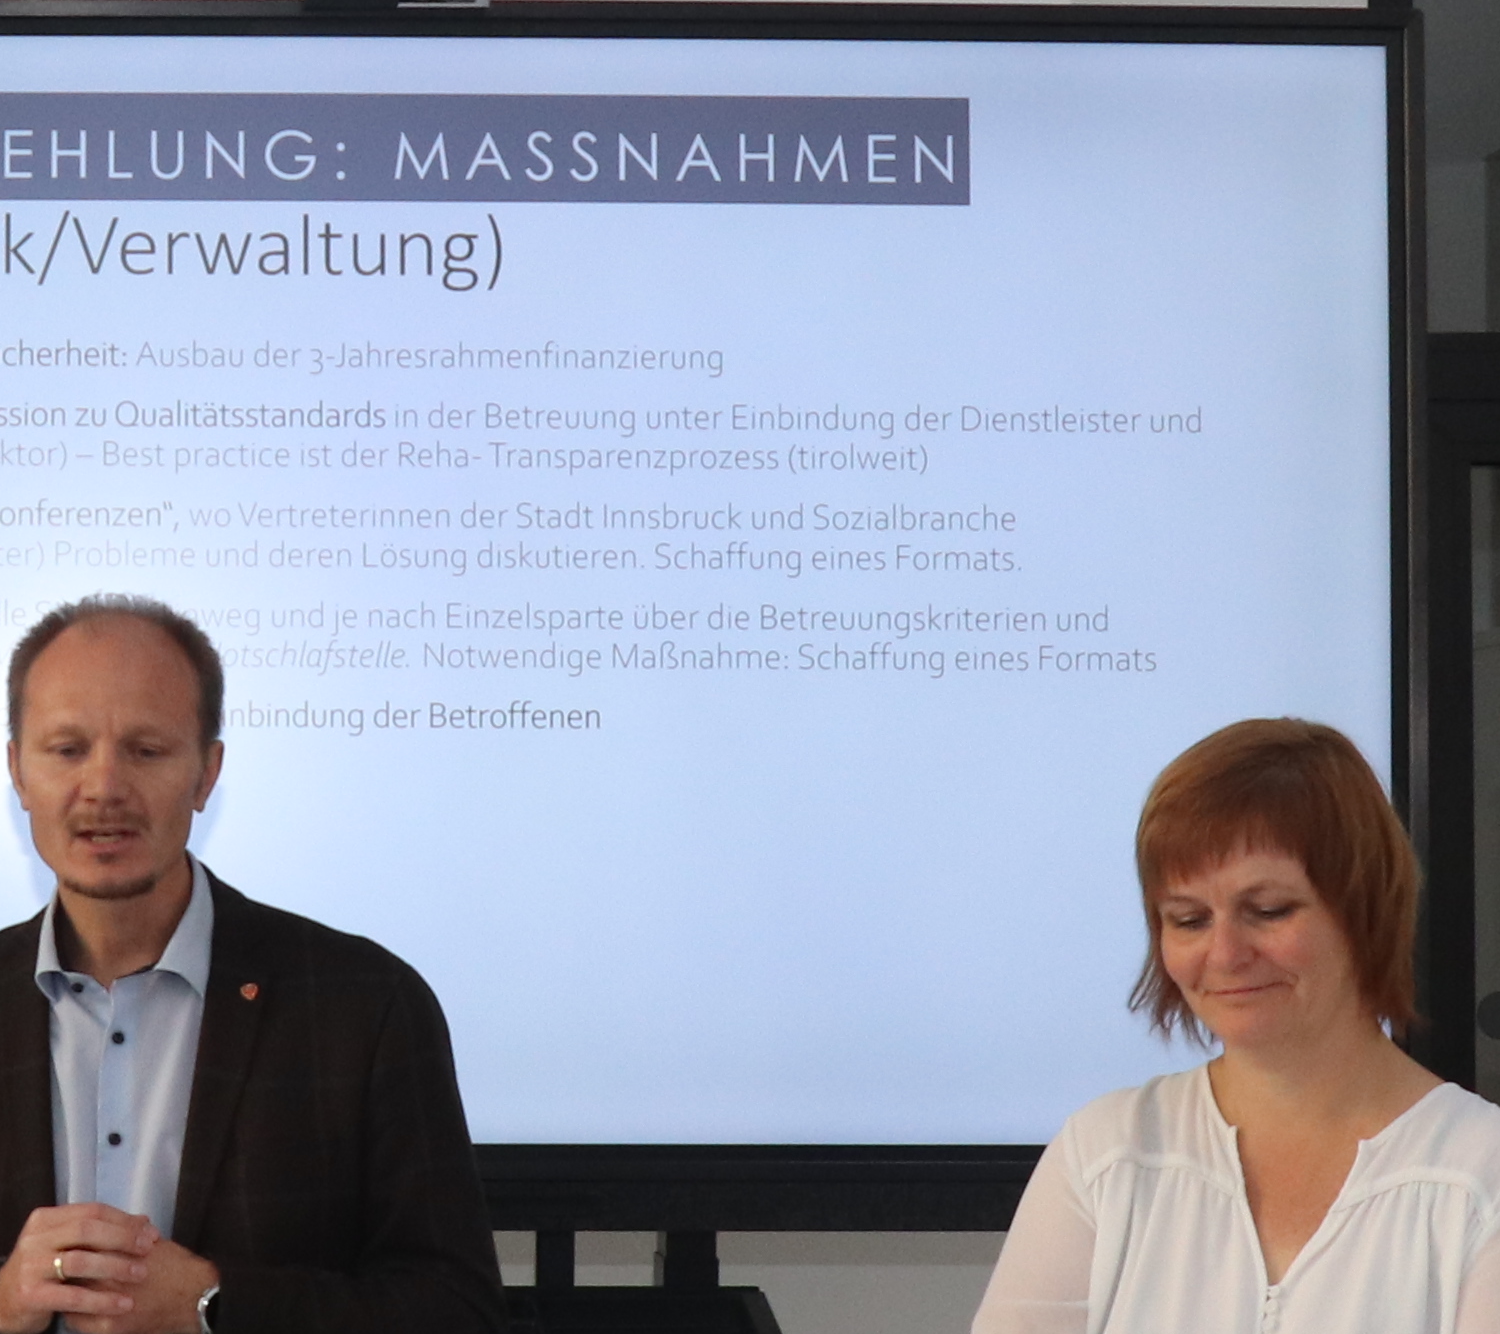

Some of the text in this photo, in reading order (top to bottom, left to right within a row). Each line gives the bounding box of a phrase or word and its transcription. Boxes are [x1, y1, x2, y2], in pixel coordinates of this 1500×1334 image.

[393, 130, 955, 184] MASSNAHMEN
[134, 338, 245, 369] Ausbau
[252, 339, 303, 369] der
[308, 339, 724, 380] 3-Jahresrahmenfinanzierung
[73, 406, 108, 429] zu
[114, 398, 387, 430] Qualitätsstandards
[394, 402, 419, 429] in
[426, 400, 477, 430] der
[484, 401, 637, 439] Betreuung
[645, 406, 724, 432] unter
[731, 402, 895, 441] Einbindung
[903, 402, 954, 433] der
[960, 403, 1143, 435] Dienstleister
[1149, 404, 1203, 435] und
[102, 439, 166, 468] Best
[174, 443, 291, 476] practice
[299, 440, 333, 469] ist
[340, 439, 390, 469] der
[397, 439, 482, 470] Reha-
[486, 441, 780, 478] Transparenzprozess
[787, 442, 929, 477] (tirolweit)
[188, 507, 233, 529] wo
[236, 500, 452, 530] Vertreterinnen
[459, 499, 510, 530] der
[515, 500, 595, 531] Stadt
[602, 501, 743, 532] Innsbruck
[750, 501, 805, 532] und
[812, 502, 1017, 533] Sozialbranche
[54, 539, 196, 569] Probleme
[205, 538, 259, 569] und
[267, 539, 353, 570] deren
[361, 541, 468, 578] Lösung
[476, 539, 646, 571] diskutieren.
[654, 540, 803, 580] Schaffung
[810, 549, 887, 572] eines
[895, 543, 1023, 573] Formats.
[270, 599, 325, 630] und
[330, 601, 359, 638] je
[367, 599, 436, 630] nach
[445, 600, 625, 638] Einzelsparte
[633, 601, 701, 631] über
[706, 601, 751, 632] die
[759, 602, 1048, 641] Betreuungskriterien
[1055, 603, 1110, 634] und
[218, 638, 411, 677] otschlafstelle.
[422, 640, 603, 679] Notwendige
[611, 639, 790, 671] Maßnahme:
[797, 640, 946, 681] Schaffung
[954, 650, 1030, 673] eines
[1038, 644, 1158, 673] Formats
[372, 699, 422, 730] der
[428, 699, 602, 731] Betroffenen
